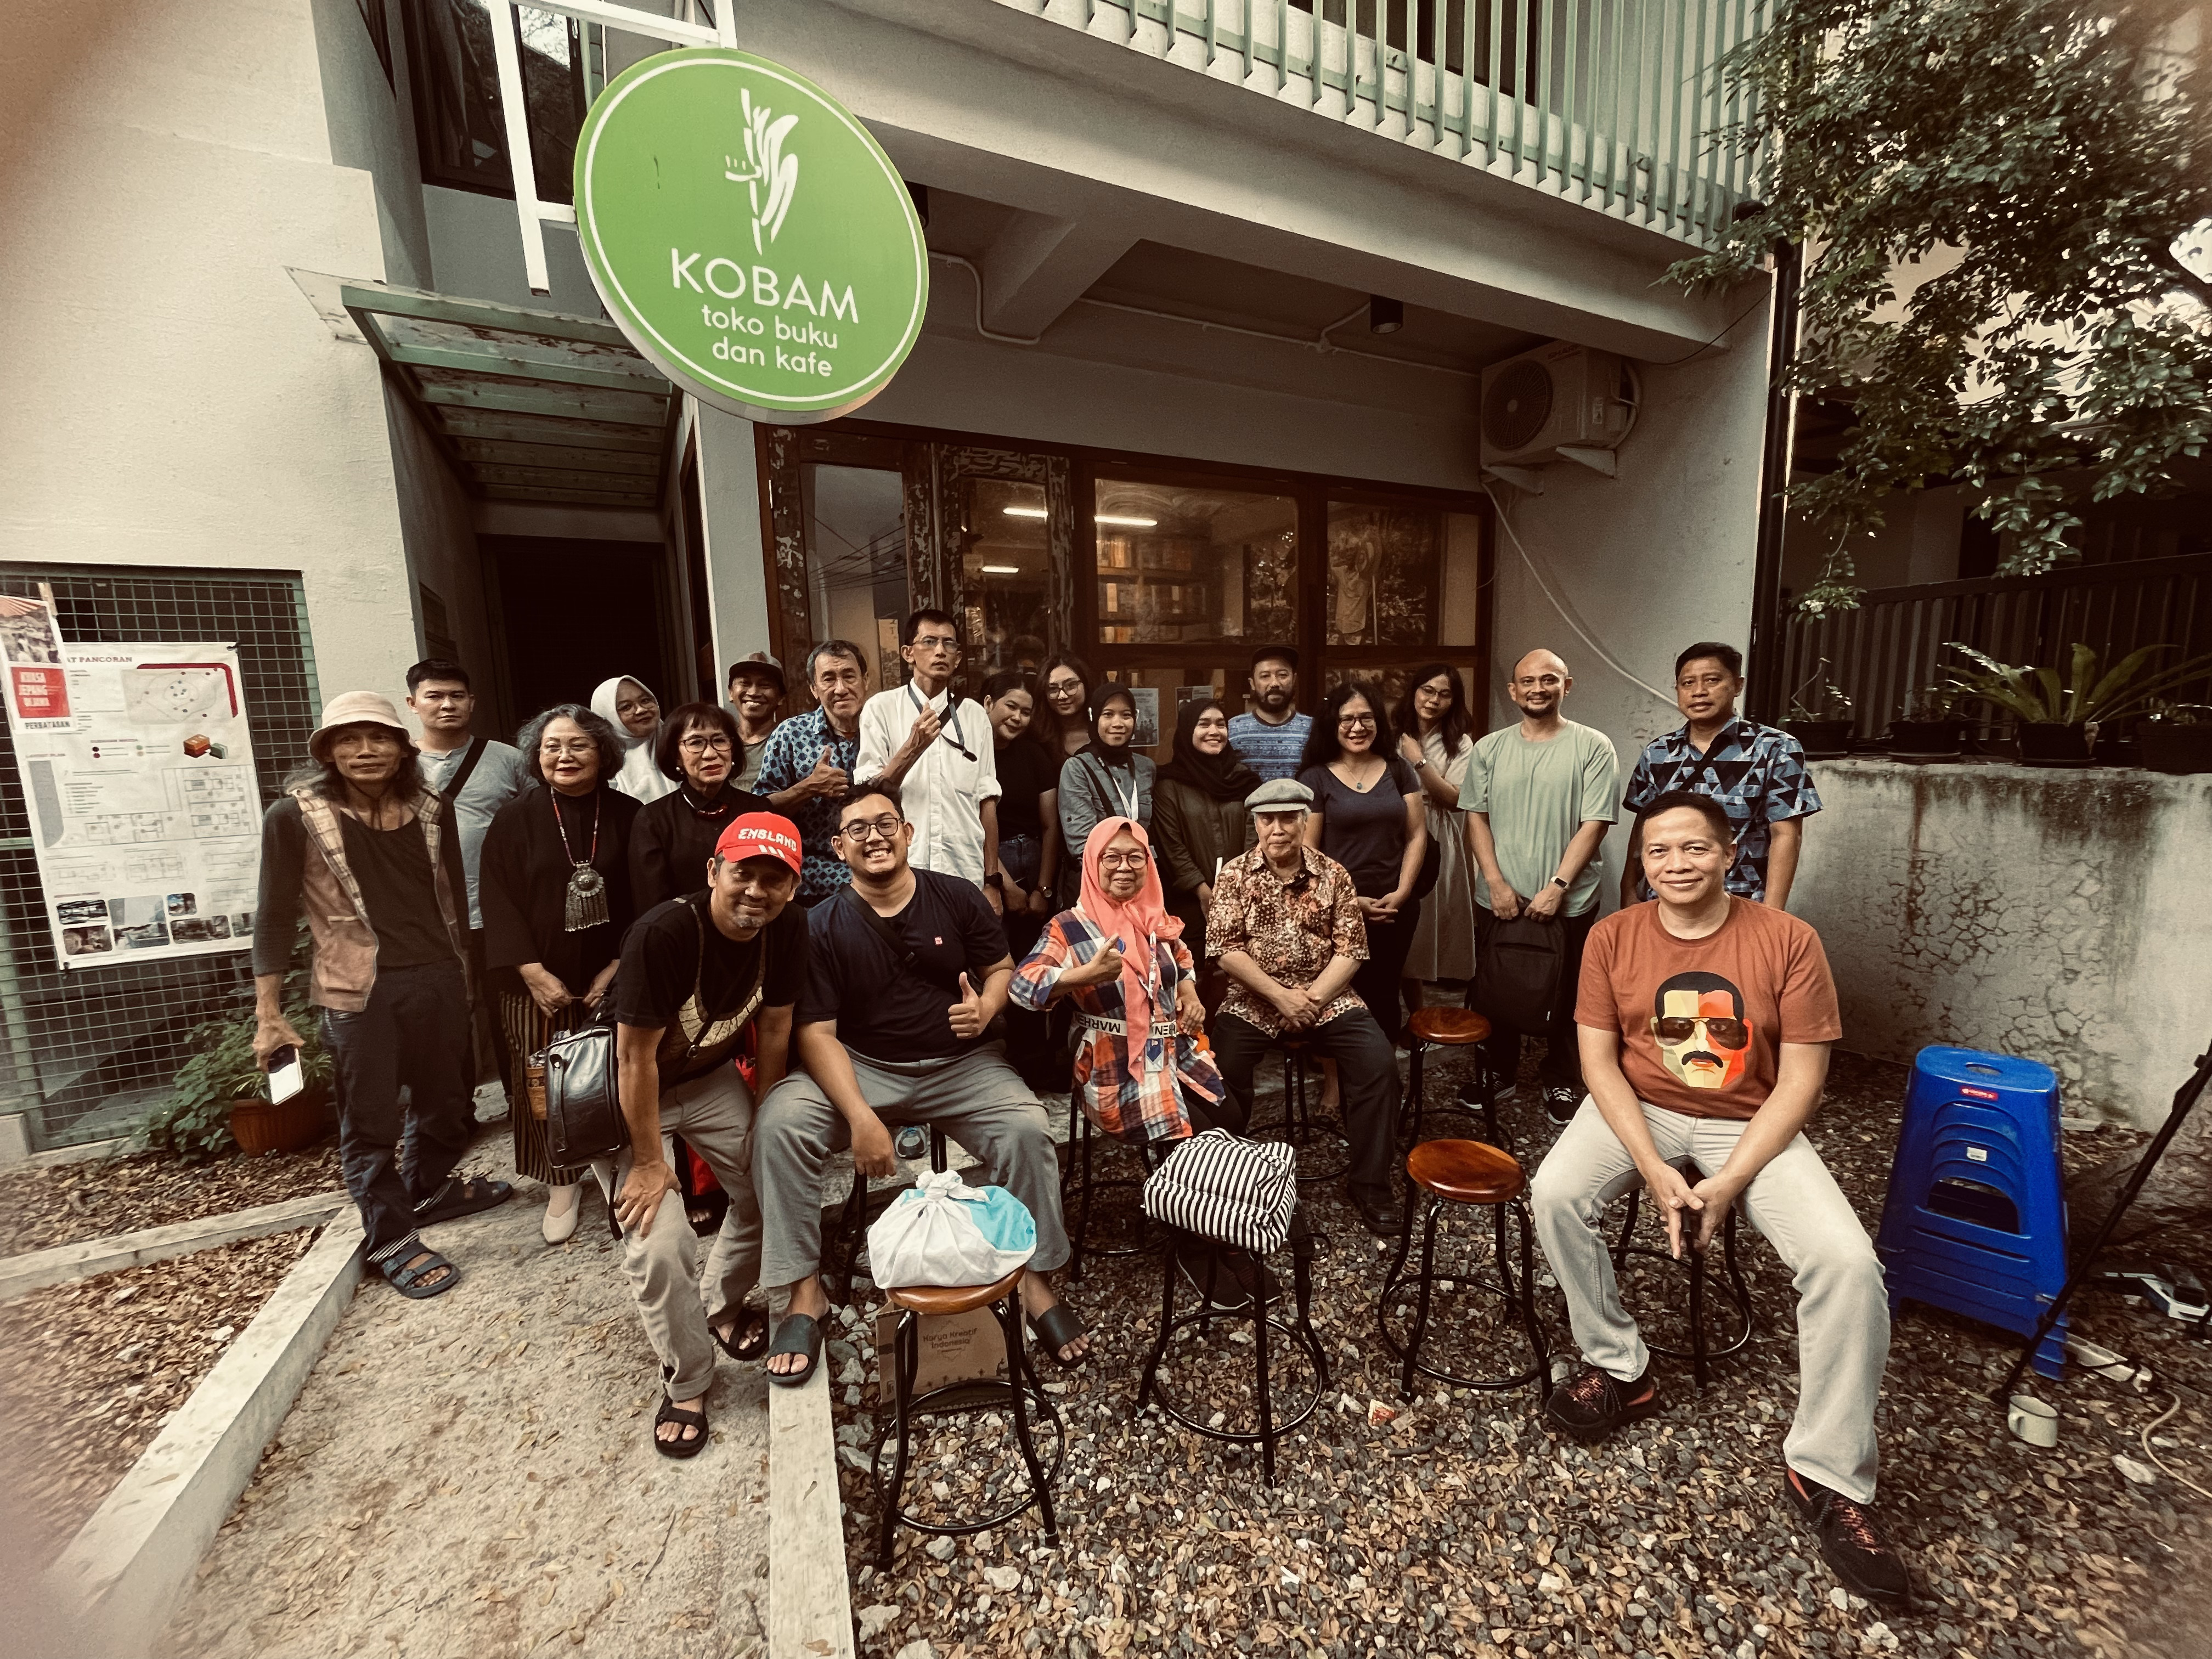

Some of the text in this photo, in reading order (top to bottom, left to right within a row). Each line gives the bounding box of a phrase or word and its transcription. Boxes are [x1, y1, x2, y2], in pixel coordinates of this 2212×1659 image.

[670, 247, 859, 324] KOBAM
[701, 304, 838, 349] toko buku
[712, 337, 833, 377] dan kafe
[25, 721, 71, 730] PERBATASAN
[738, 828, 797, 851] ENGLAND
[923, 1328, 978, 1342] Karya Kreatif
[932, 1338, 970, 1348] Indonesia
